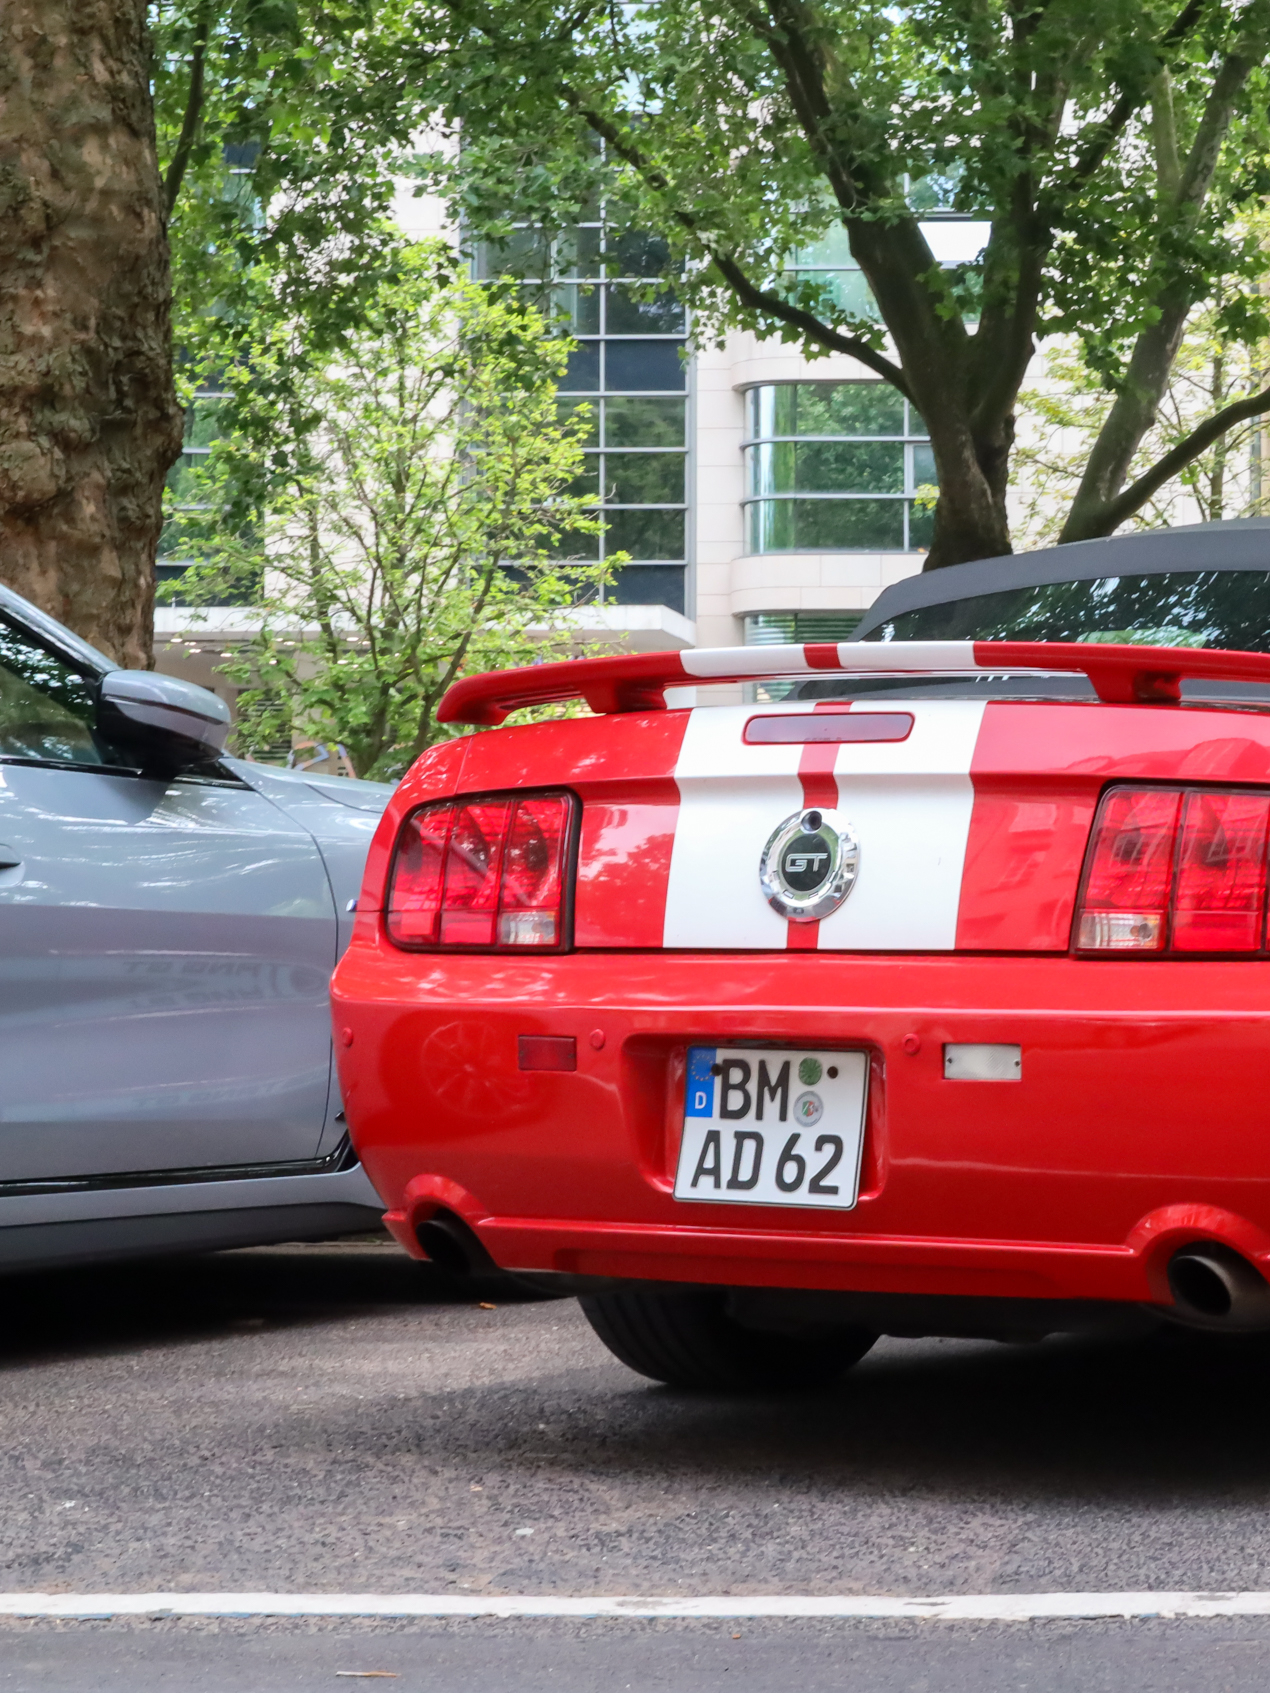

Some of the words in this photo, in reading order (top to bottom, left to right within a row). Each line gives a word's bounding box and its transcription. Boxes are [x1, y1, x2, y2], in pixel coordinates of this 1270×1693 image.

[785, 853, 828, 873] GT
[695, 1091, 707, 1109] D
[719, 1058, 791, 1122] BM
[690, 1129, 764, 1190] AD
[775, 1132, 844, 1195] 62
